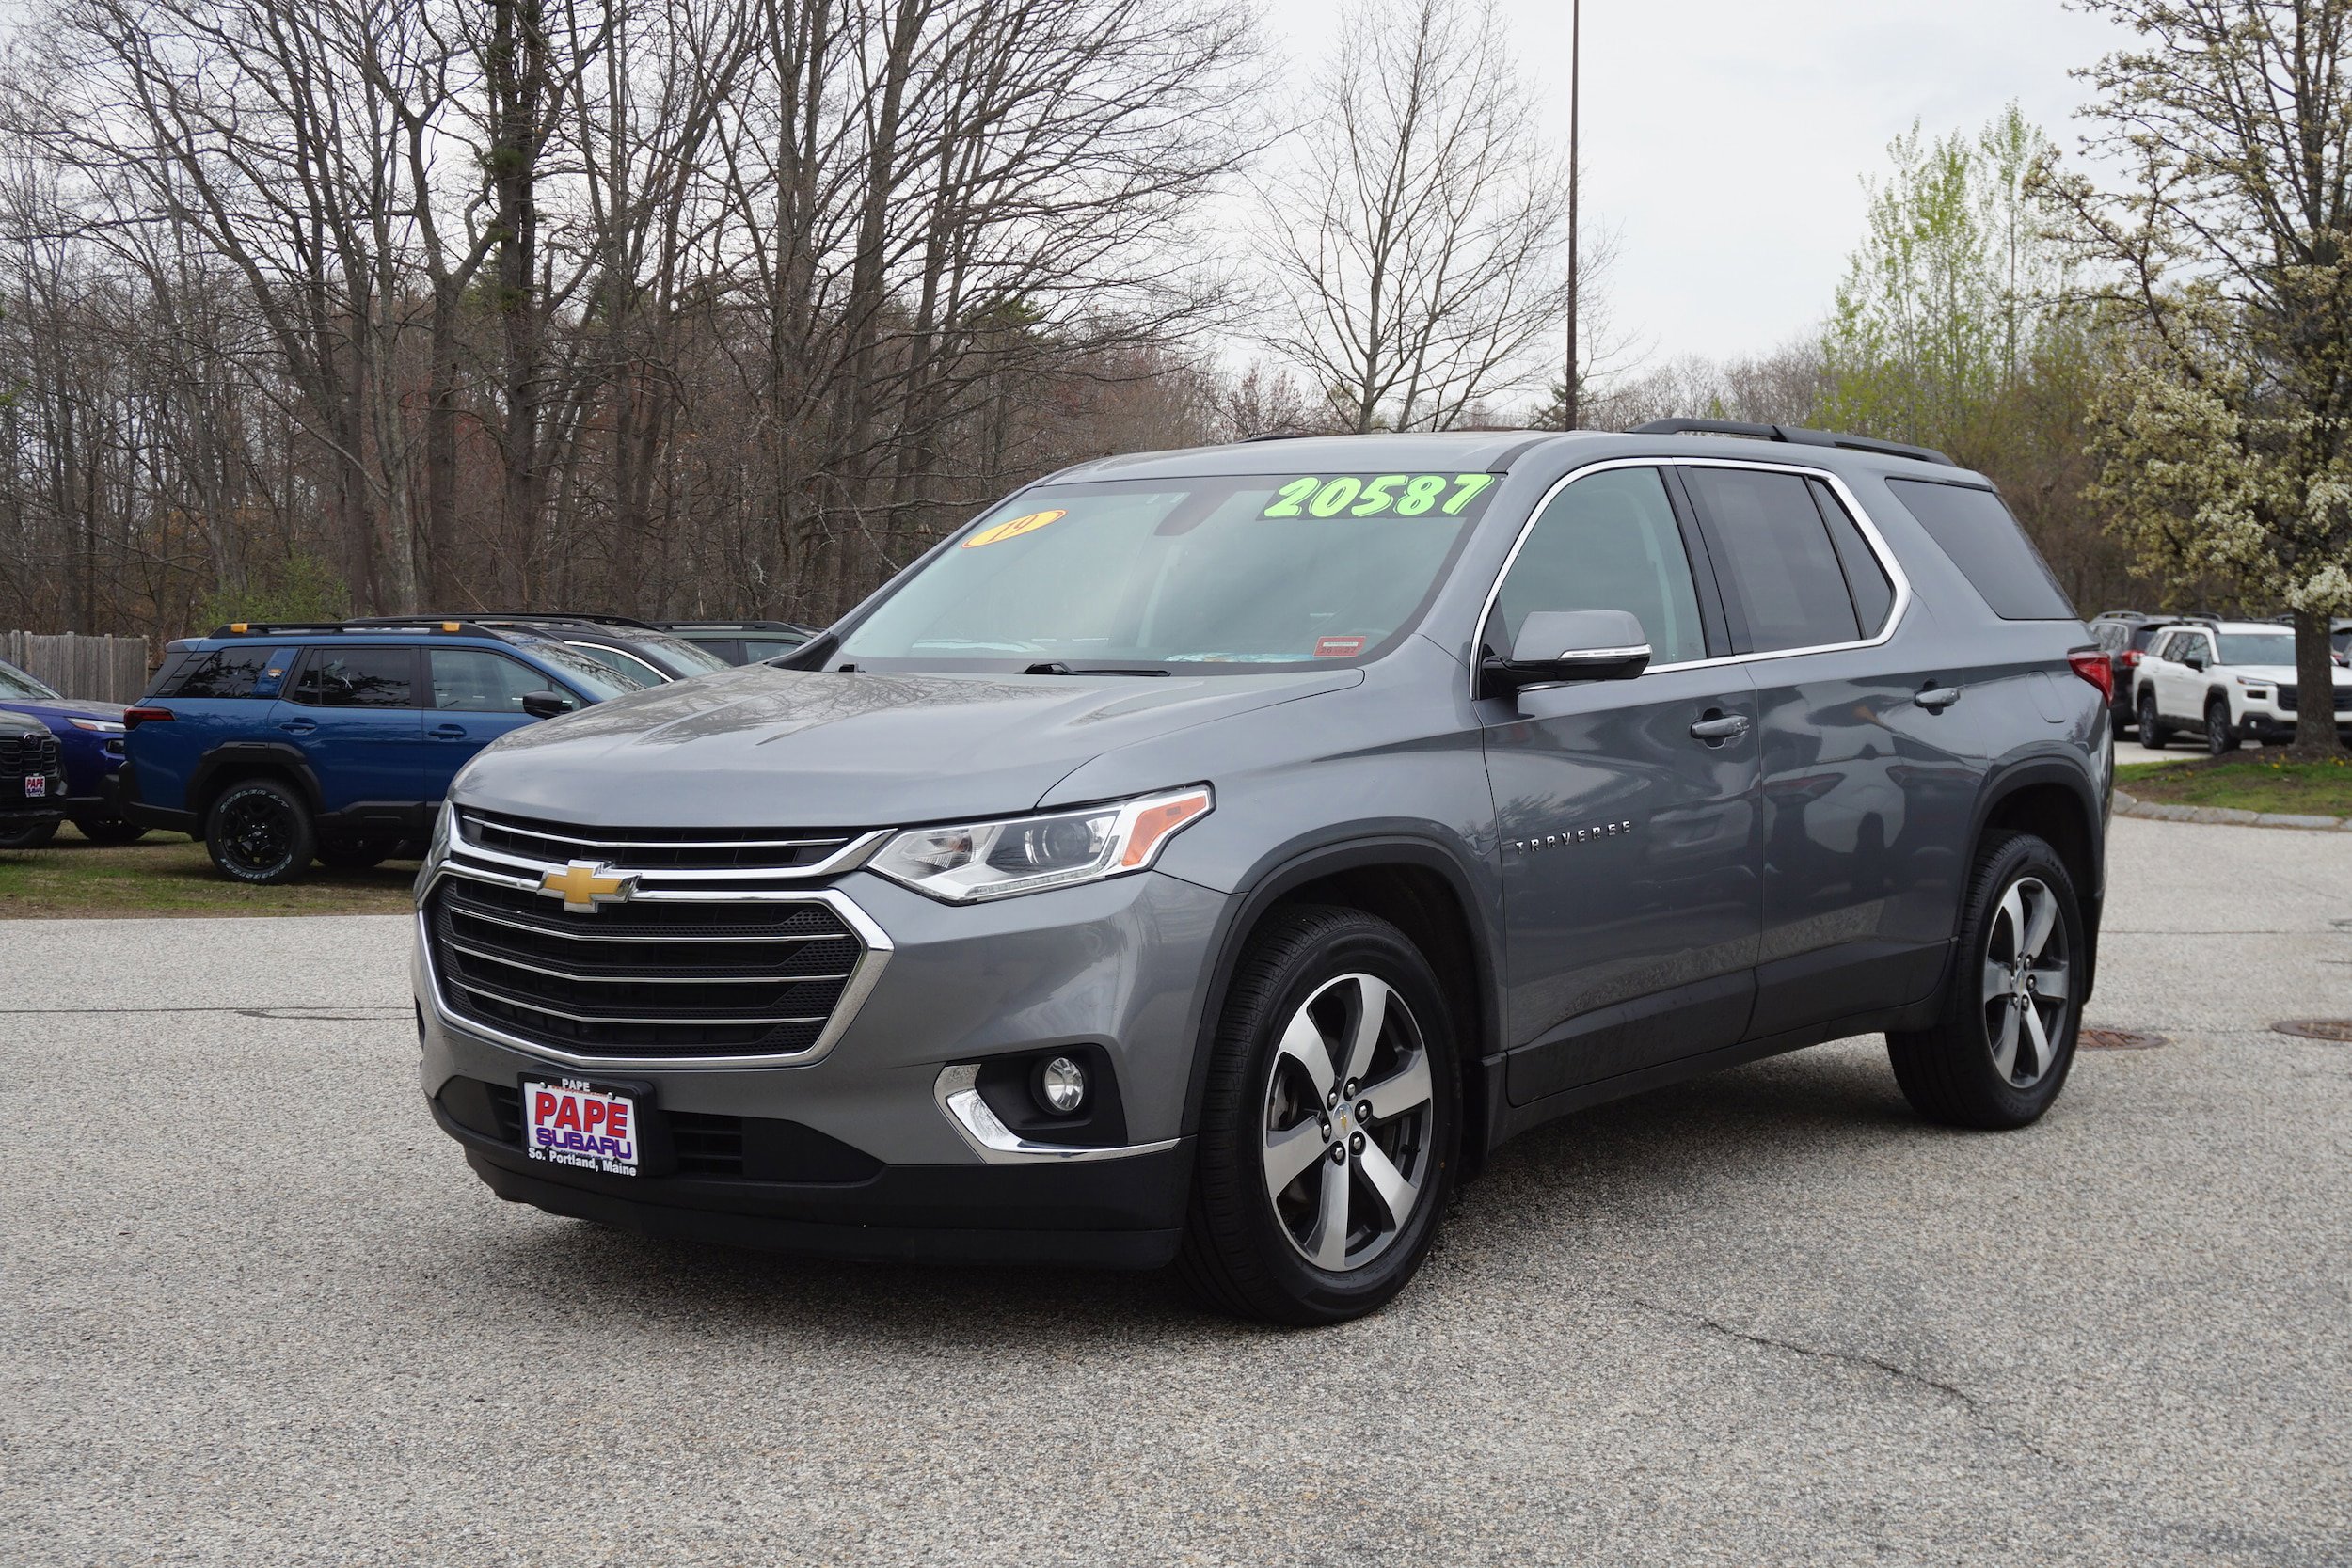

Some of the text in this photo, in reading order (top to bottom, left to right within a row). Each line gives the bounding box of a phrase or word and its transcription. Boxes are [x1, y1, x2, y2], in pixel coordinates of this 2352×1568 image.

[1263, 474, 1496, 517] 20587
[1515, 820, 1631, 855] TRAVERSE
[562, 1078, 591, 1092] PAPE
[534, 1091, 628, 1139] PAPE
[535, 1127, 632, 1160] SUBARU
[528, 1147, 546, 1161] So.
[549, 1150, 599, 1172] Portland,
[603, 1159, 637, 1177] Maine
